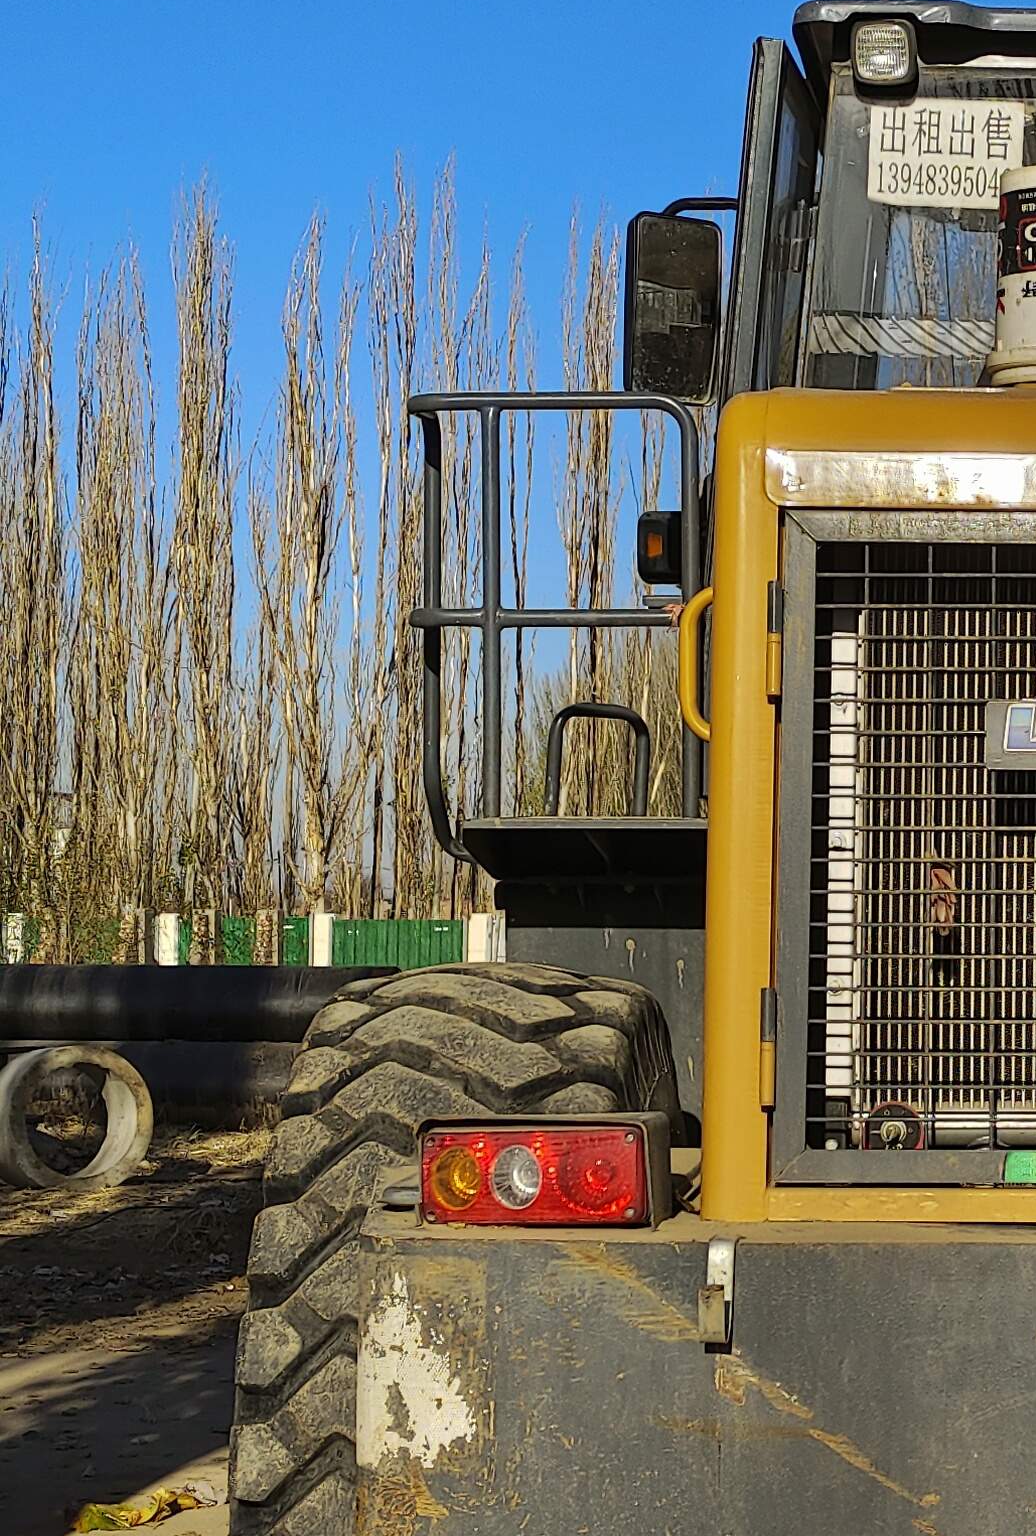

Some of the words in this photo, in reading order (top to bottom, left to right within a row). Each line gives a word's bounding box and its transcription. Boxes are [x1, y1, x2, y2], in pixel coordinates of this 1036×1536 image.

[879, 107, 1013, 161] 出租出售
[877, 161, 1010, 198] 1394839504
